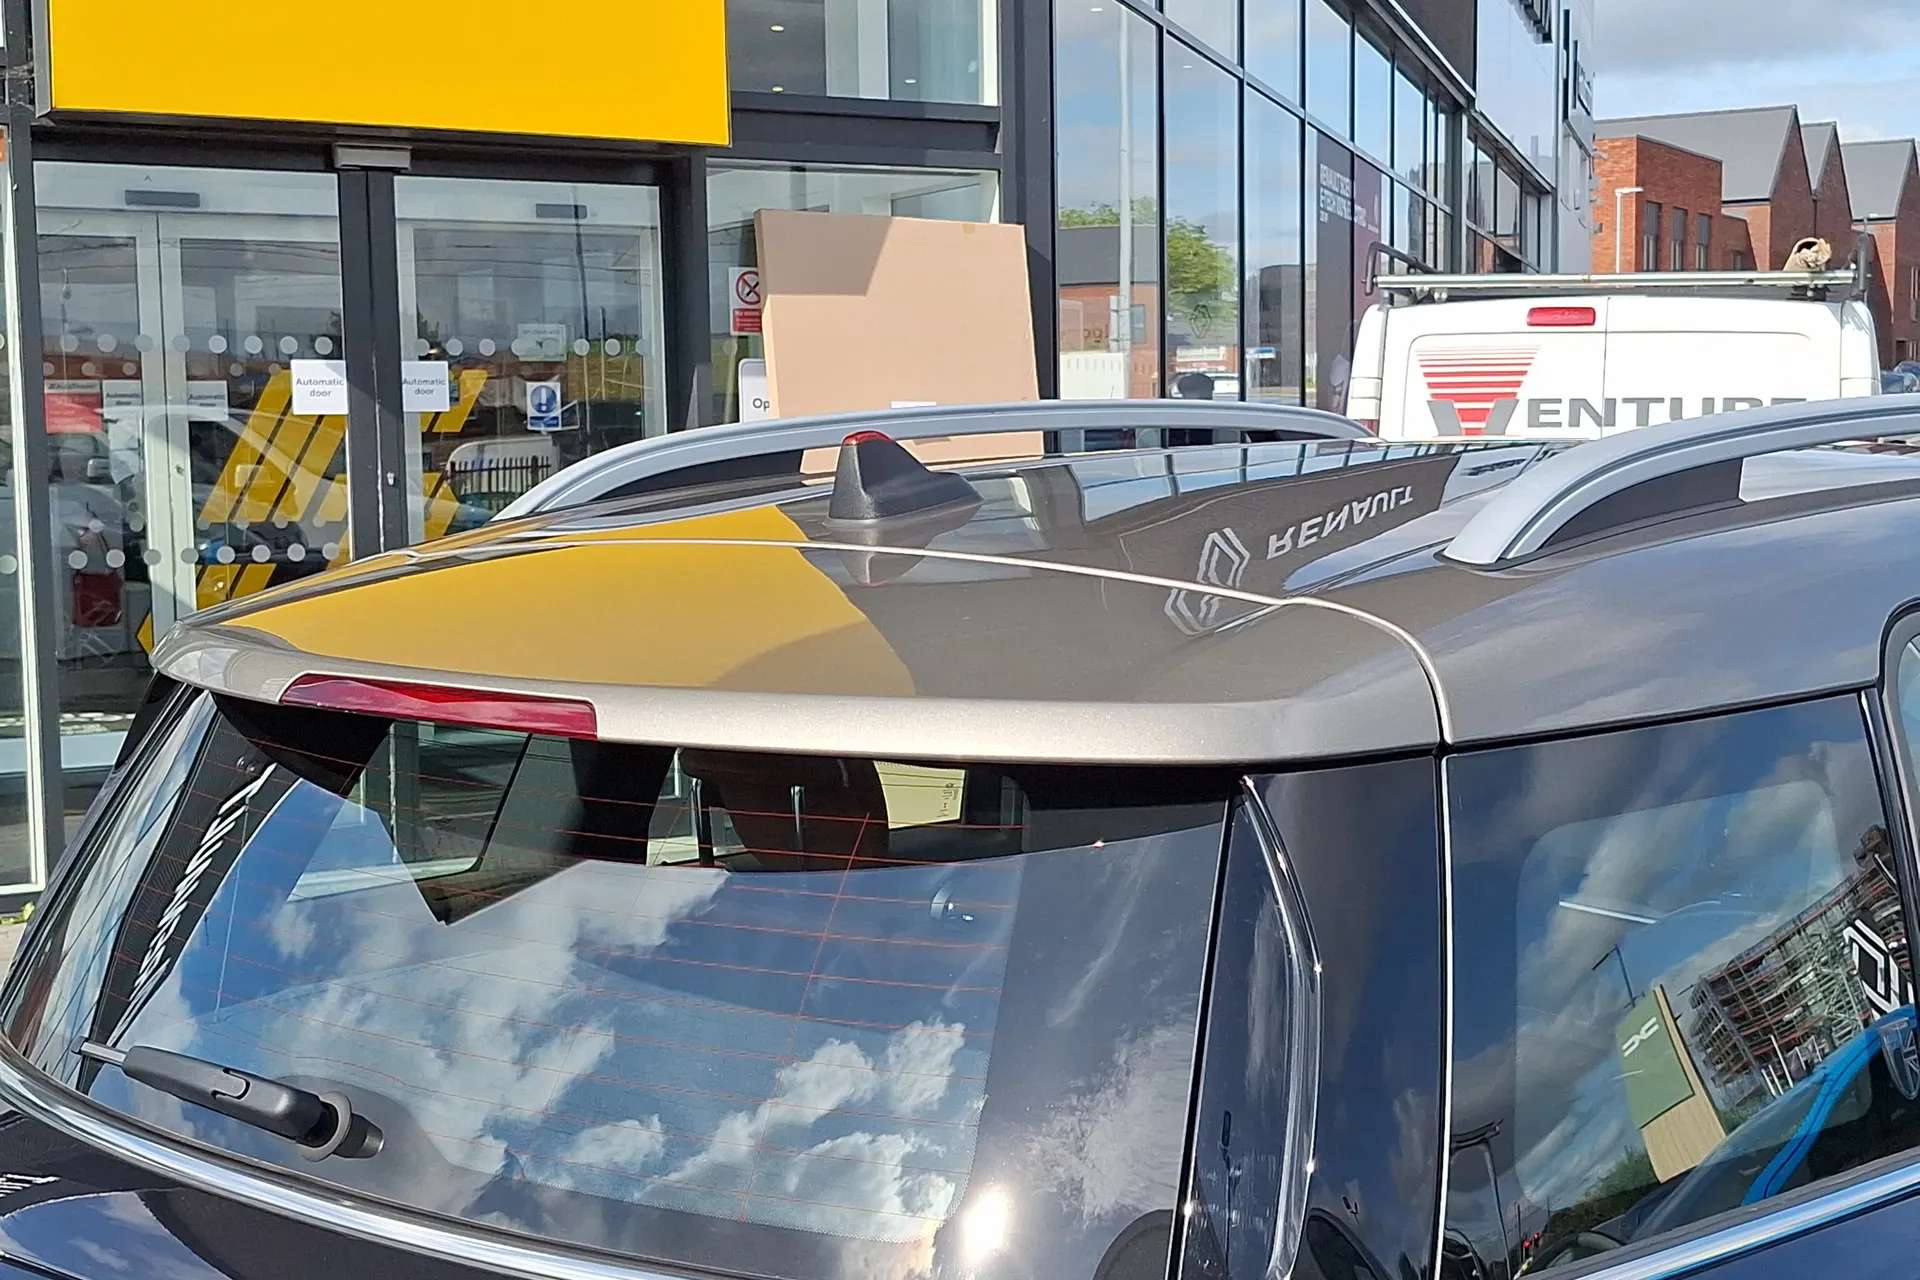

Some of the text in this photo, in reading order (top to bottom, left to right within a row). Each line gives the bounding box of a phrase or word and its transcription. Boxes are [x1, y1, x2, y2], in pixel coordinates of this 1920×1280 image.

[295, 376, 345, 386] Automatic
[402, 376, 446, 386] Automatic
[309, 389, 333, 398] door
[413, 388, 435, 396] door
[1427, 397, 1808, 436] VENTU
